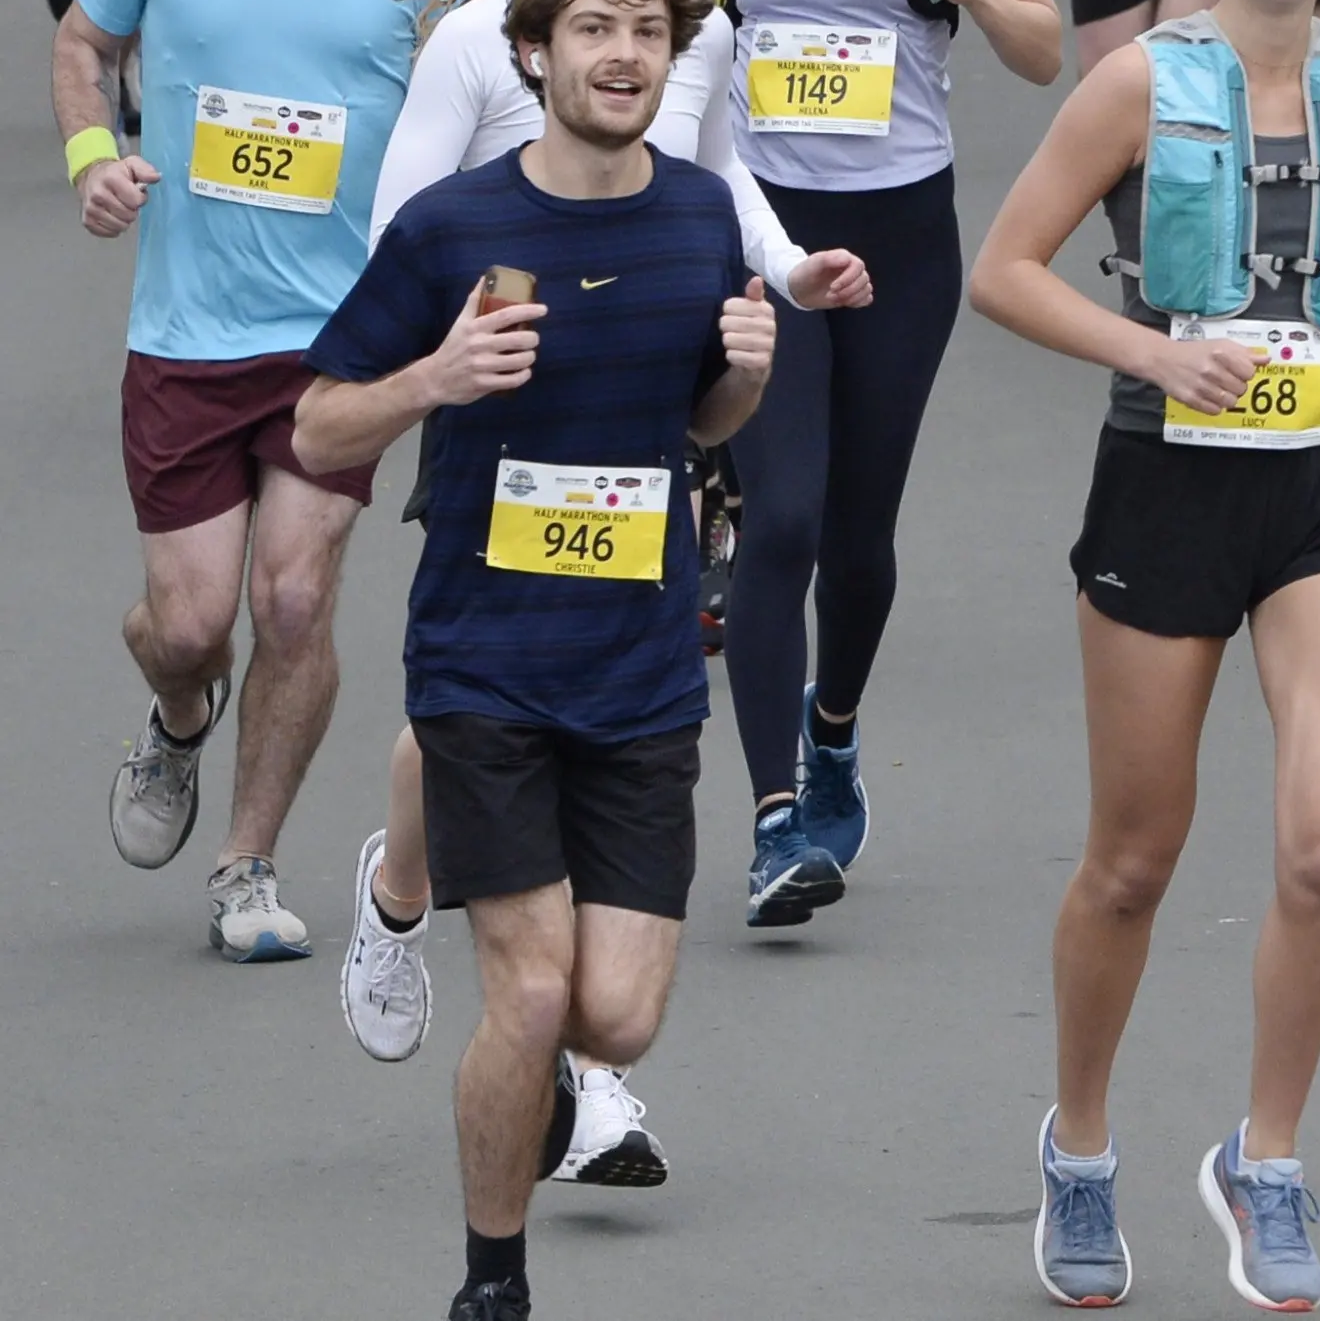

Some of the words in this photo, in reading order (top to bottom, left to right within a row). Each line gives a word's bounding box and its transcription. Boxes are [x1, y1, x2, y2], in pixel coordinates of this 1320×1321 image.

[777, 61, 797, 70] HALF
[799, 63, 842, 72] MARATHON
[844, 65, 861, 73] RUN
[786, 73, 848, 105] 1149
[799, 107, 828, 115] HELENA
[225, 128, 244, 138] HALF
[247, 133, 291, 147] MARATHON
[293, 140, 310, 149] RUN
[232, 144, 293, 181] 652
[249, 179, 269, 190] KARL
[1255, 366, 1285, 376] ATHON
[1289, 366, 1305, 376] RUN
[1242, 418, 1266, 427] LUCY
[1173, 429, 1194, 439] 1268
[534, 507, 557, 519] HALF
[560, 510, 611, 522] MARATHON
[613, 513, 630, 522] RUN
[544, 522, 614, 562] 946
[555, 562, 596, 574] CHRISTIE
